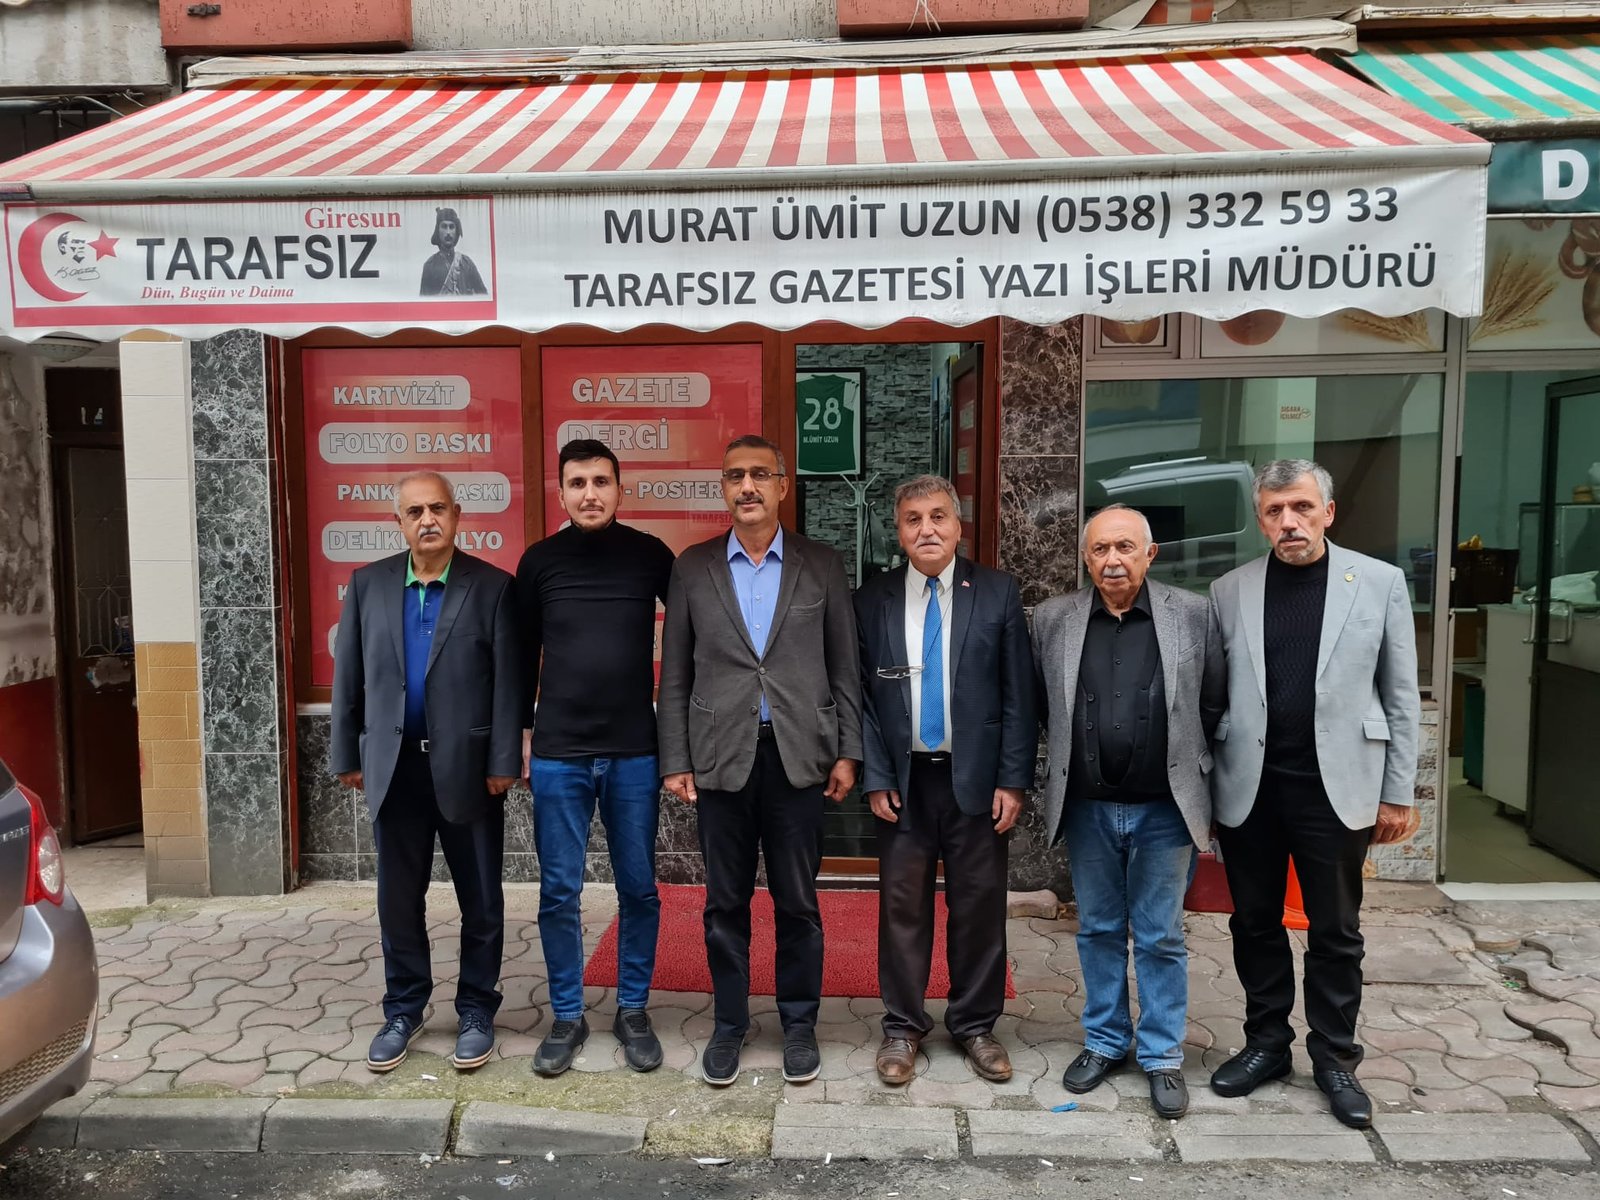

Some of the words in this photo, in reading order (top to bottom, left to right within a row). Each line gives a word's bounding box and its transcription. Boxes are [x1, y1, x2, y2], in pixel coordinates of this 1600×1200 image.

[304, 206, 402, 230] Giresun
[604, 207, 758, 244] MURAT
[772, 195, 886, 241] ÜMİT
[900, 199, 1021, 237] UZUN
[1036, 191, 1171, 242] (0538)
[1186, 190, 1264, 229] 332
[1280, 188, 1331, 225] 59
[1347, 187, 1398, 222] 33
[136, 234, 380, 281] TARAFSIZ
[564, 271, 757, 308] TARAFSIZ
[769, 257, 964, 304] GAZETESİ
[978, 263, 1068, 299] YAZI
[1085, 249, 1210, 305] İŞLERİ
[1227, 242, 1436, 292] MÜDÜRÜ
[141, 286, 175, 299] Dün,
[180, 286, 225, 301] Bugün
[231, 289, 245, 298] ve
[249, 285, 294, 298] Daima
[333, 380, 455, 406] KARTVİZİT
[572, 377, 691, 403] GAZETE
[803, 397, 842, 430] 28
[329, 432, 409, 454] FOLYO
[415, 432, 492, 454] BASKI
[567, 417, 669, 451] DERGİ
[454, 483, 504, 501] ASKI
